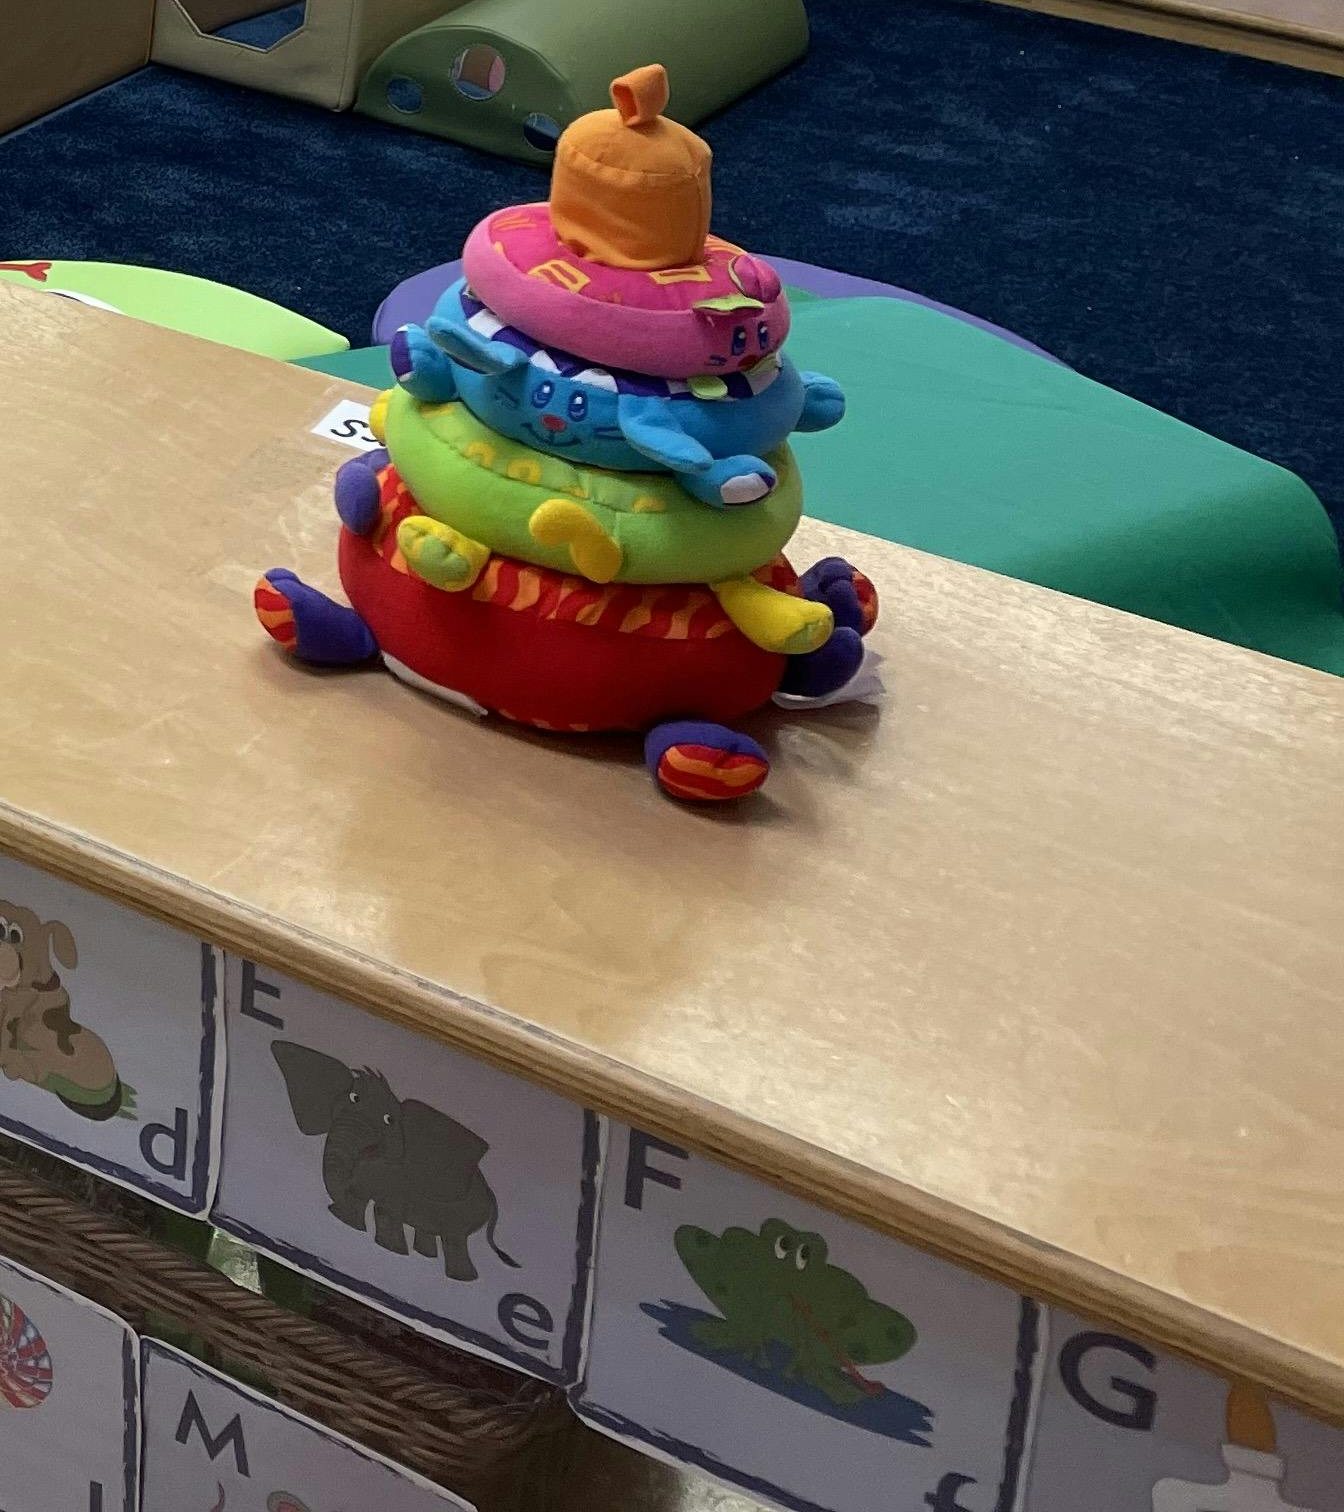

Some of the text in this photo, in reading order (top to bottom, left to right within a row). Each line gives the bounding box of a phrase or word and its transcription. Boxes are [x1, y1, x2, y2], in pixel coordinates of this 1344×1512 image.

[240, 960, 284, 1030] E
[139, 1106, 189, 1181] d
[624, 1127, 691, 1211] F
[497, 1292, 554, 1350] e
[1058, 1330, 1157, 1432] G
[175, 1389, 250, 1478] M
